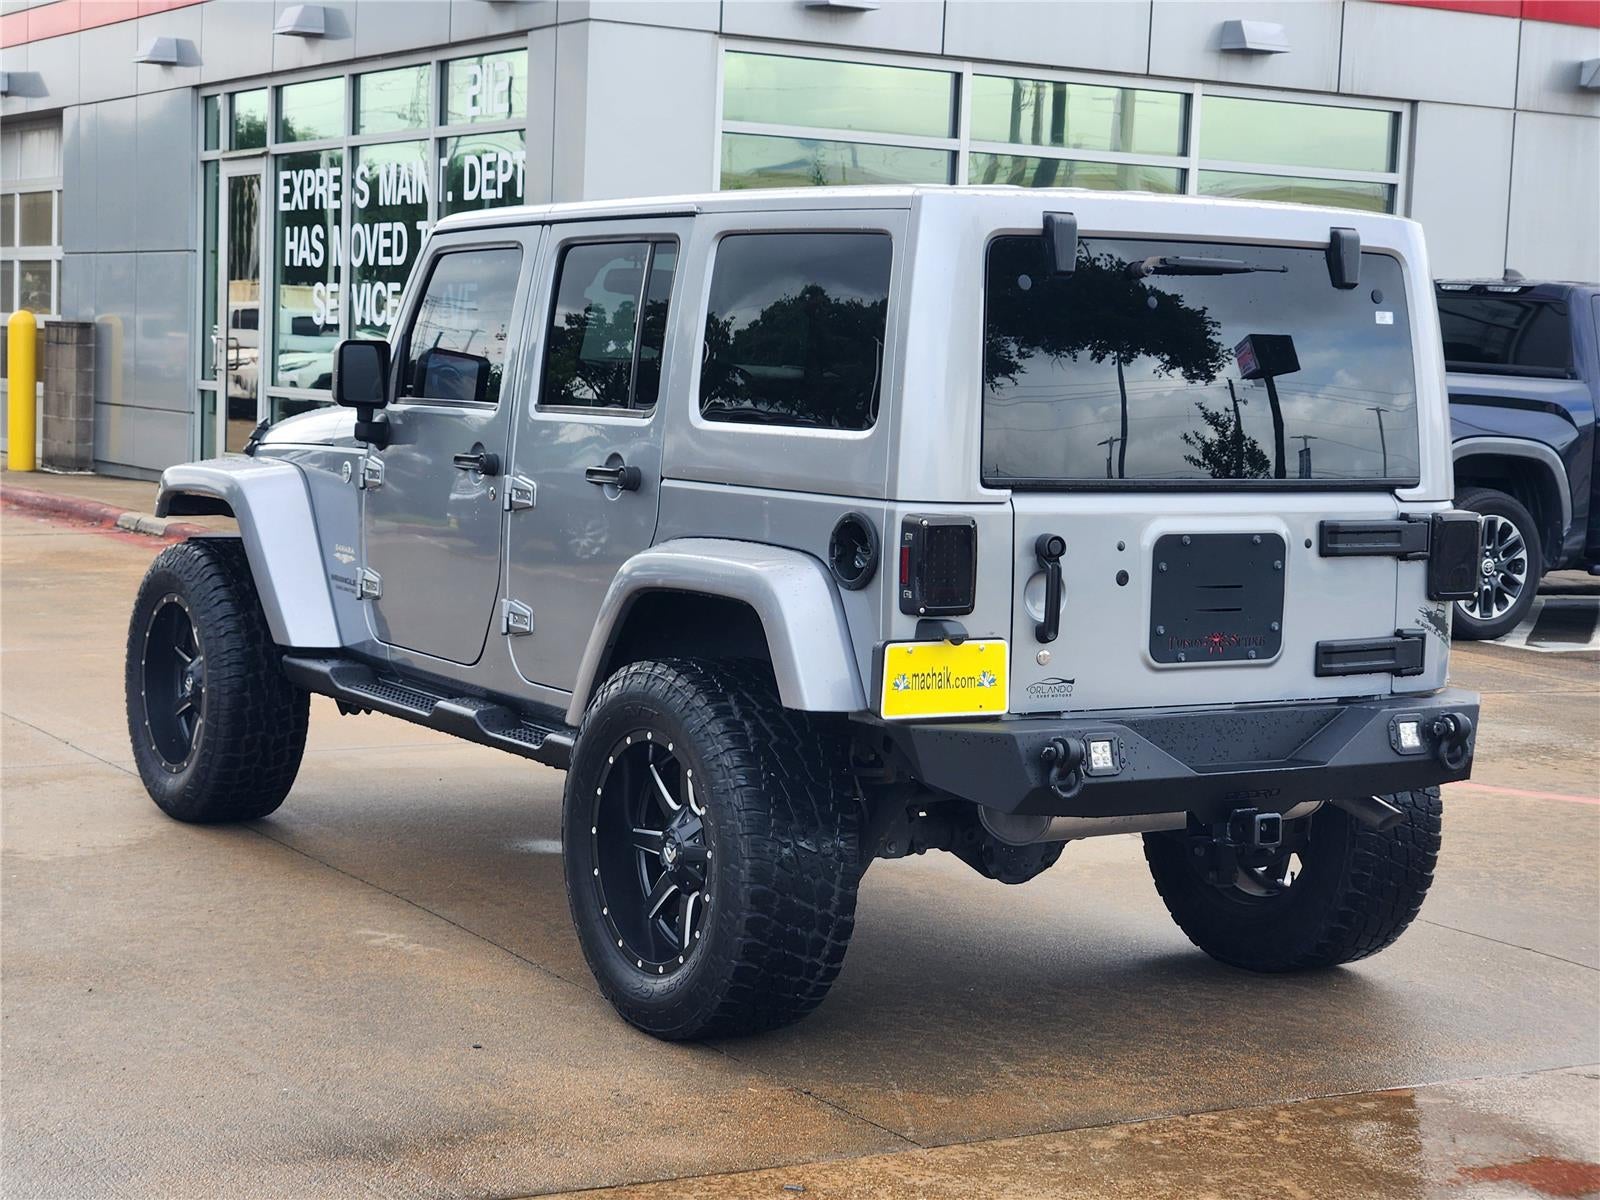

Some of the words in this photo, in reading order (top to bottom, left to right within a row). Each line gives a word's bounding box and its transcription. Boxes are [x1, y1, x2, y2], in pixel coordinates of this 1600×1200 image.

[467, 61, 510, 116] 2112
[279, 164, 369, 211] EXPRES
[464, 151, 526, 200] DEPT
[285, 224, 324, 268] HAS
[312, 281, 401, 327] SEVICE
[911, 664, 976, 690] machaik.com
[1030, 685, 1073, 694] ORLANDO
